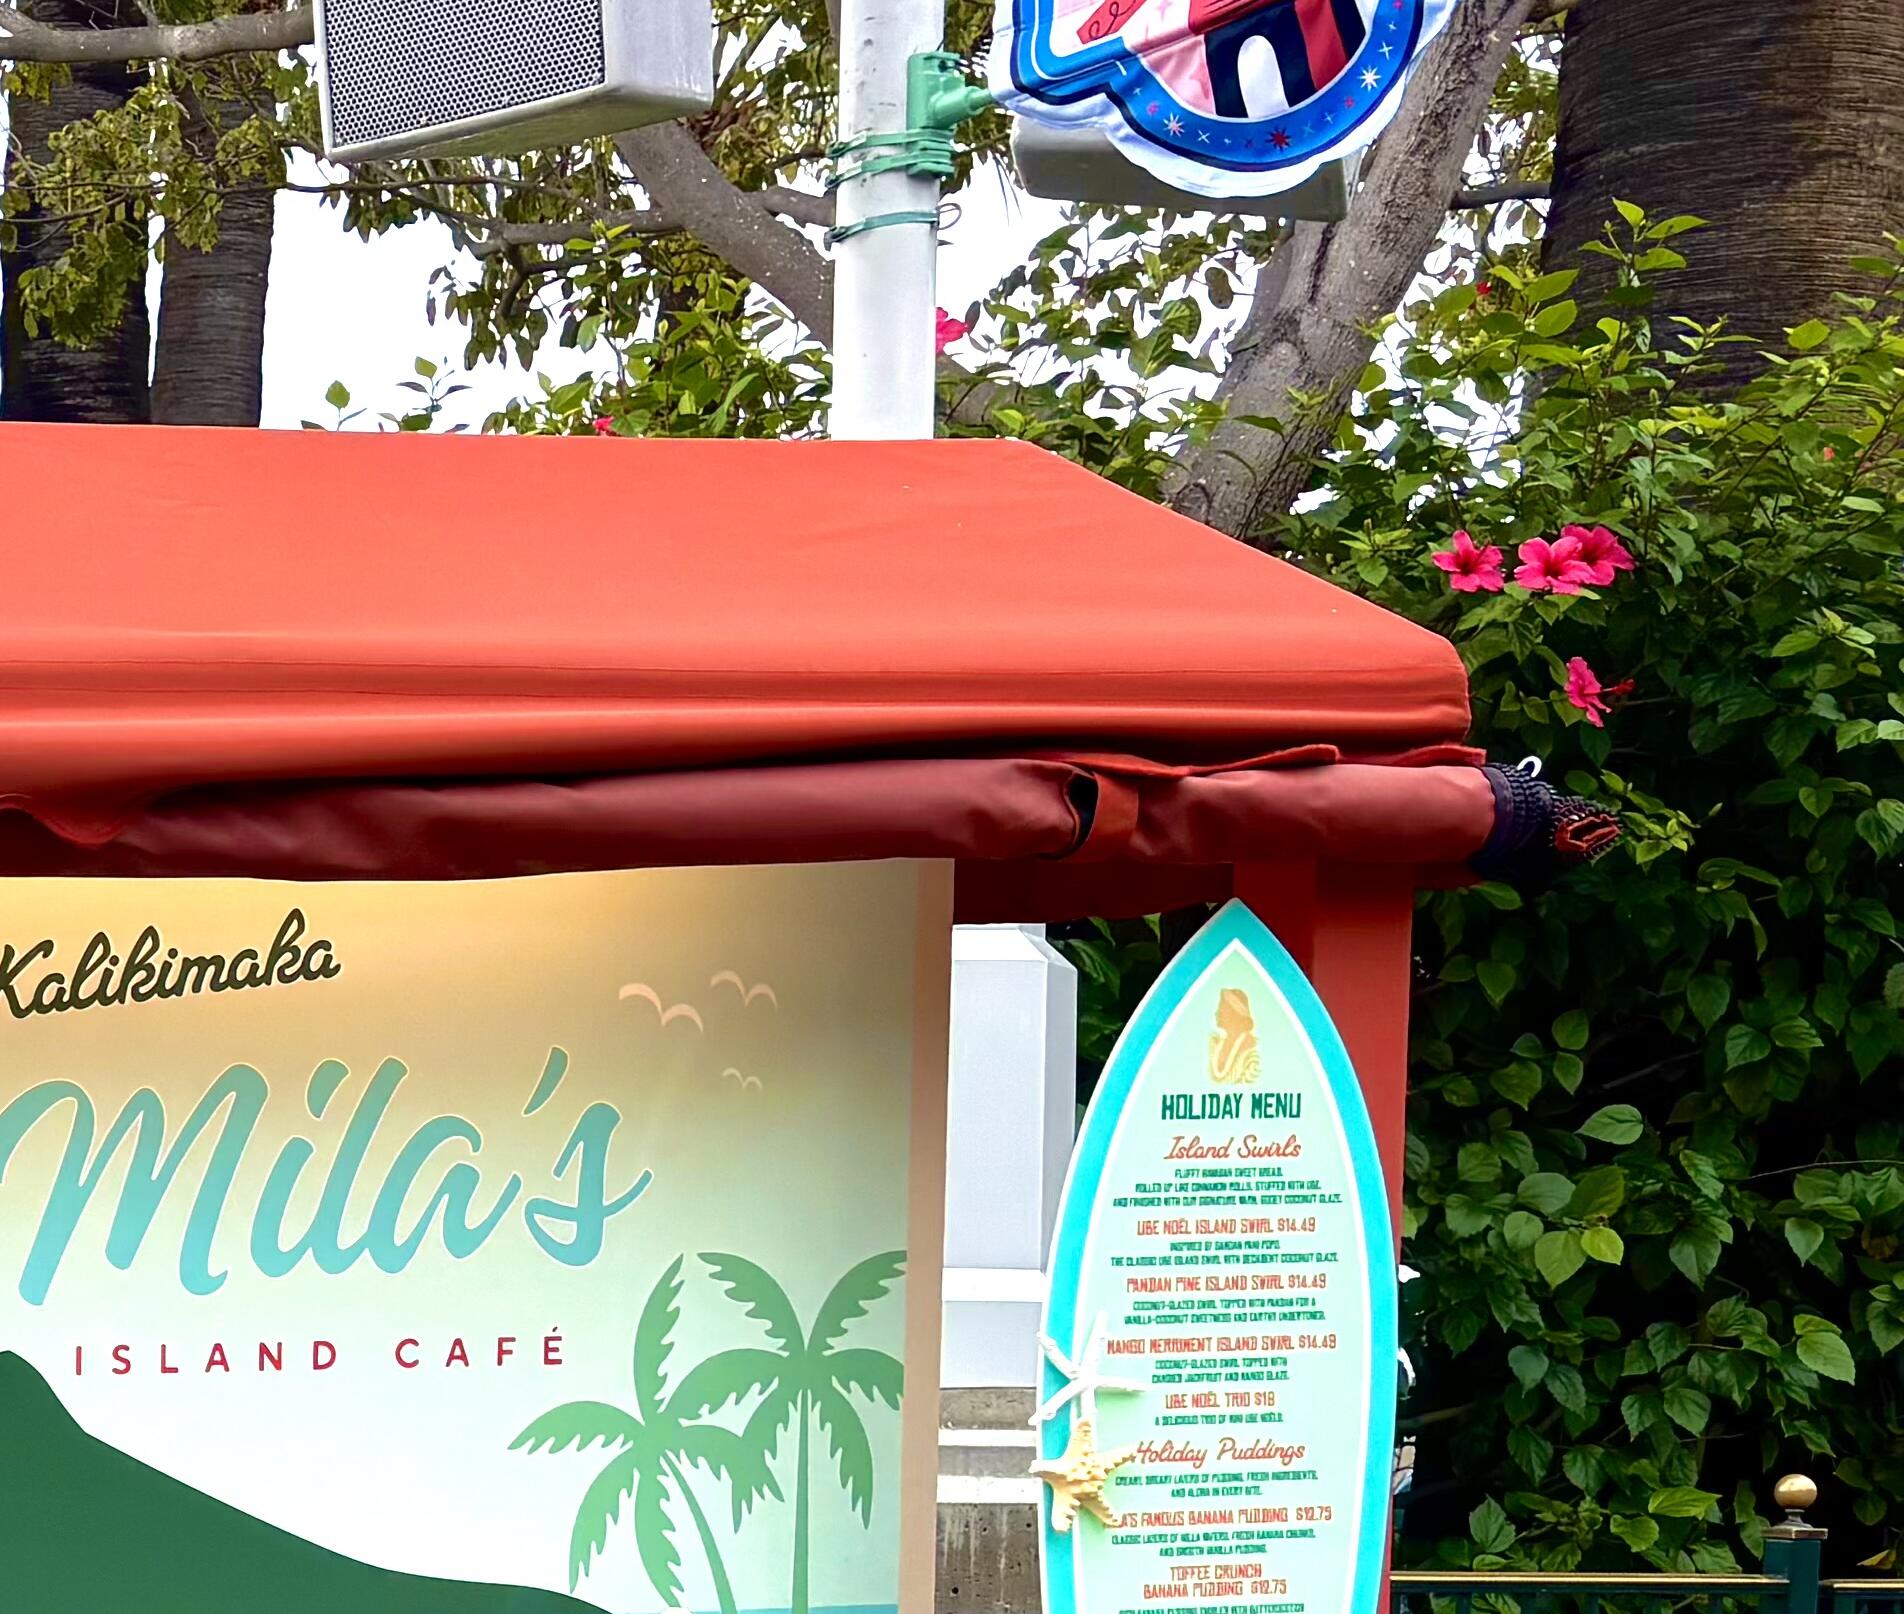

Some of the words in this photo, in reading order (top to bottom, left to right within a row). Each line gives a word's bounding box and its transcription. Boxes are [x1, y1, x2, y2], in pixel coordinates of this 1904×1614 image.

[1161, 1094, 1243, 1120] HOLIDAY
[1251, 1092, 1301, 1119] MENU
[1164, 1136, 1234, 1160] Island
[1237, 1134, 1302, 1158] Swirls
[1137, 1220, 1160, 1235] UBE
[1163, 1218, 1192, 1235] NOËL
[1195, 1219, 1237, 1234] ISLAND
[1240, 1218, 1274, 1234] SWIRL
[1278, 1217, 1316, 1233] $14.49
[1127, 1277, 1172, 1293] PANDAN
[1176, 1276, 1202, 1292] PINE
[1205, 1275, 1248, 1291] ISLAND
[1251, 1275, 1285, 1290] SWIRL
[1288, 1273, 1327, 1289] $14.49
[76, 1340, 338, 1376] ISLAND
[395, 1326, 566, 1369] CAFÉ
[1107, 1339, 1146, 1355] MANGO
[1150, 1337, 1213, 1354] MERRIMENT
[1217, 1336, 1257, 1352] ISLAND
[1261, 1335, 1295, 1351] SWIRL
[1299, 1334, 1337, 1350] $14.49
[1166, 1394, 1188, 1410] UBE
[1192, 1391, 1221, 1408] NOËL
[1225, 1392, 1250, 1407] TRIO
[1254, 1391, 1275, 1407] $18
[1135, 1440, 1208, 1469] Holiday
[1217, 1437, 1306, 1466] Puddings
[1141, 1511, 1185, 1527] FAMOUS
[1188, 1509, 1234, 1525] BANANA
[1238, 1507, 1289, 1523] PUDDING
[1170, 1565, 1212, 1581] TOFFEE
[1215, 1563, 1263, 1580] CRUNCH
[1144, 1584, 1189, 1600] BANANA
[1193, 1581, 1243, 1598] PUDDING
